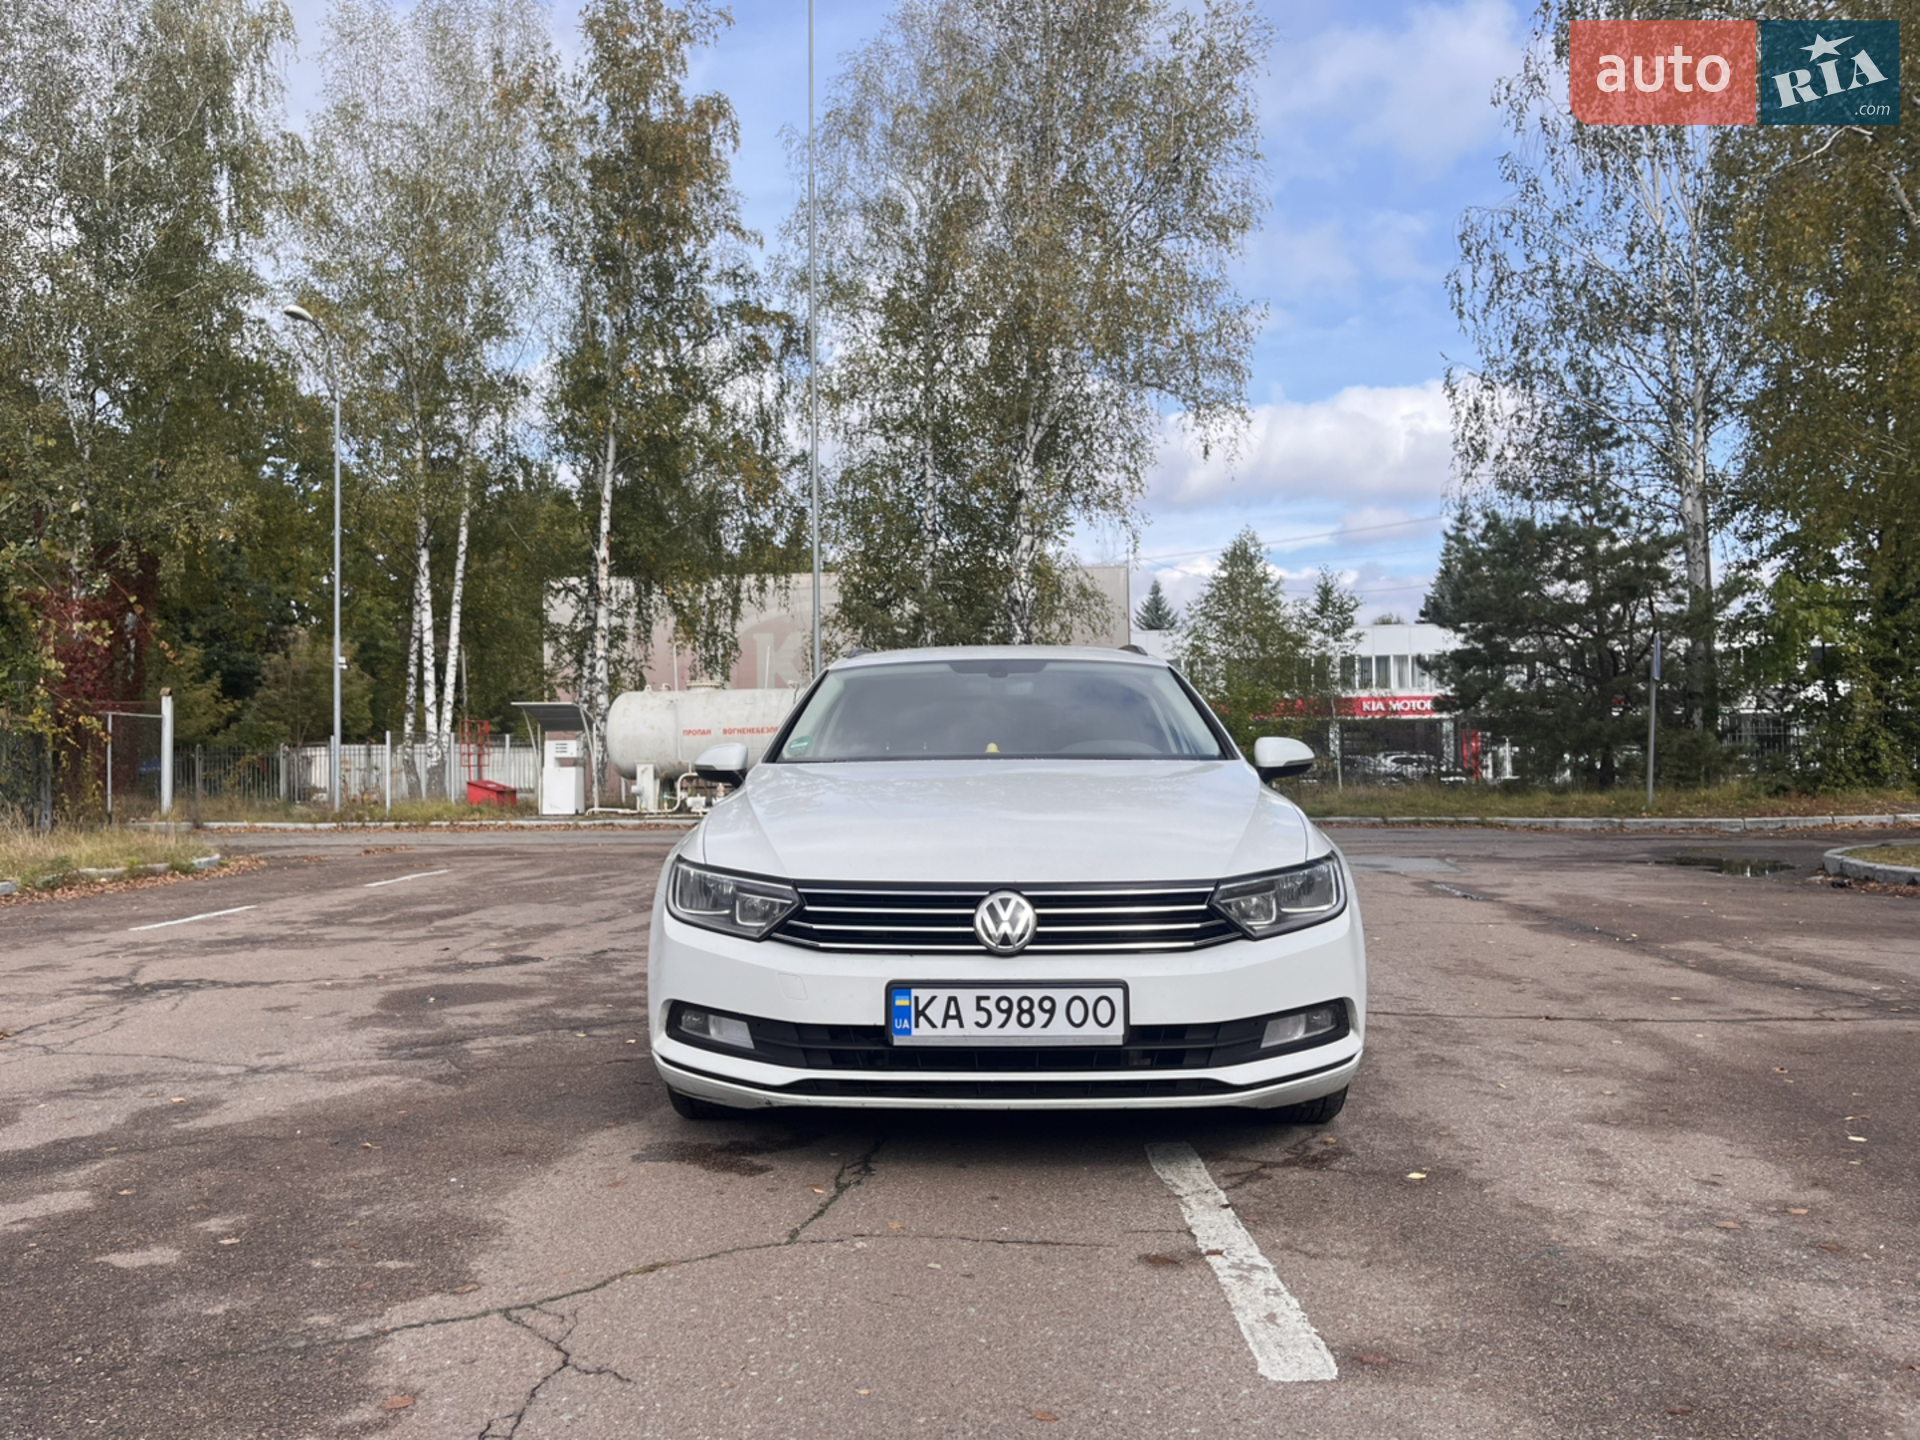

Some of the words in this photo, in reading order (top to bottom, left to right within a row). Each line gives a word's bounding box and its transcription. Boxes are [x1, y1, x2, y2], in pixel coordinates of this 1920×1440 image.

[1362, 700, 1385, 711] KIA
[682, 728, 712, 736] ПРОПАН
[913, 995, 964, 1029] KA
[974, 995, 1056, 1029] 5989
[895, 1018, 910, 1029] UA
